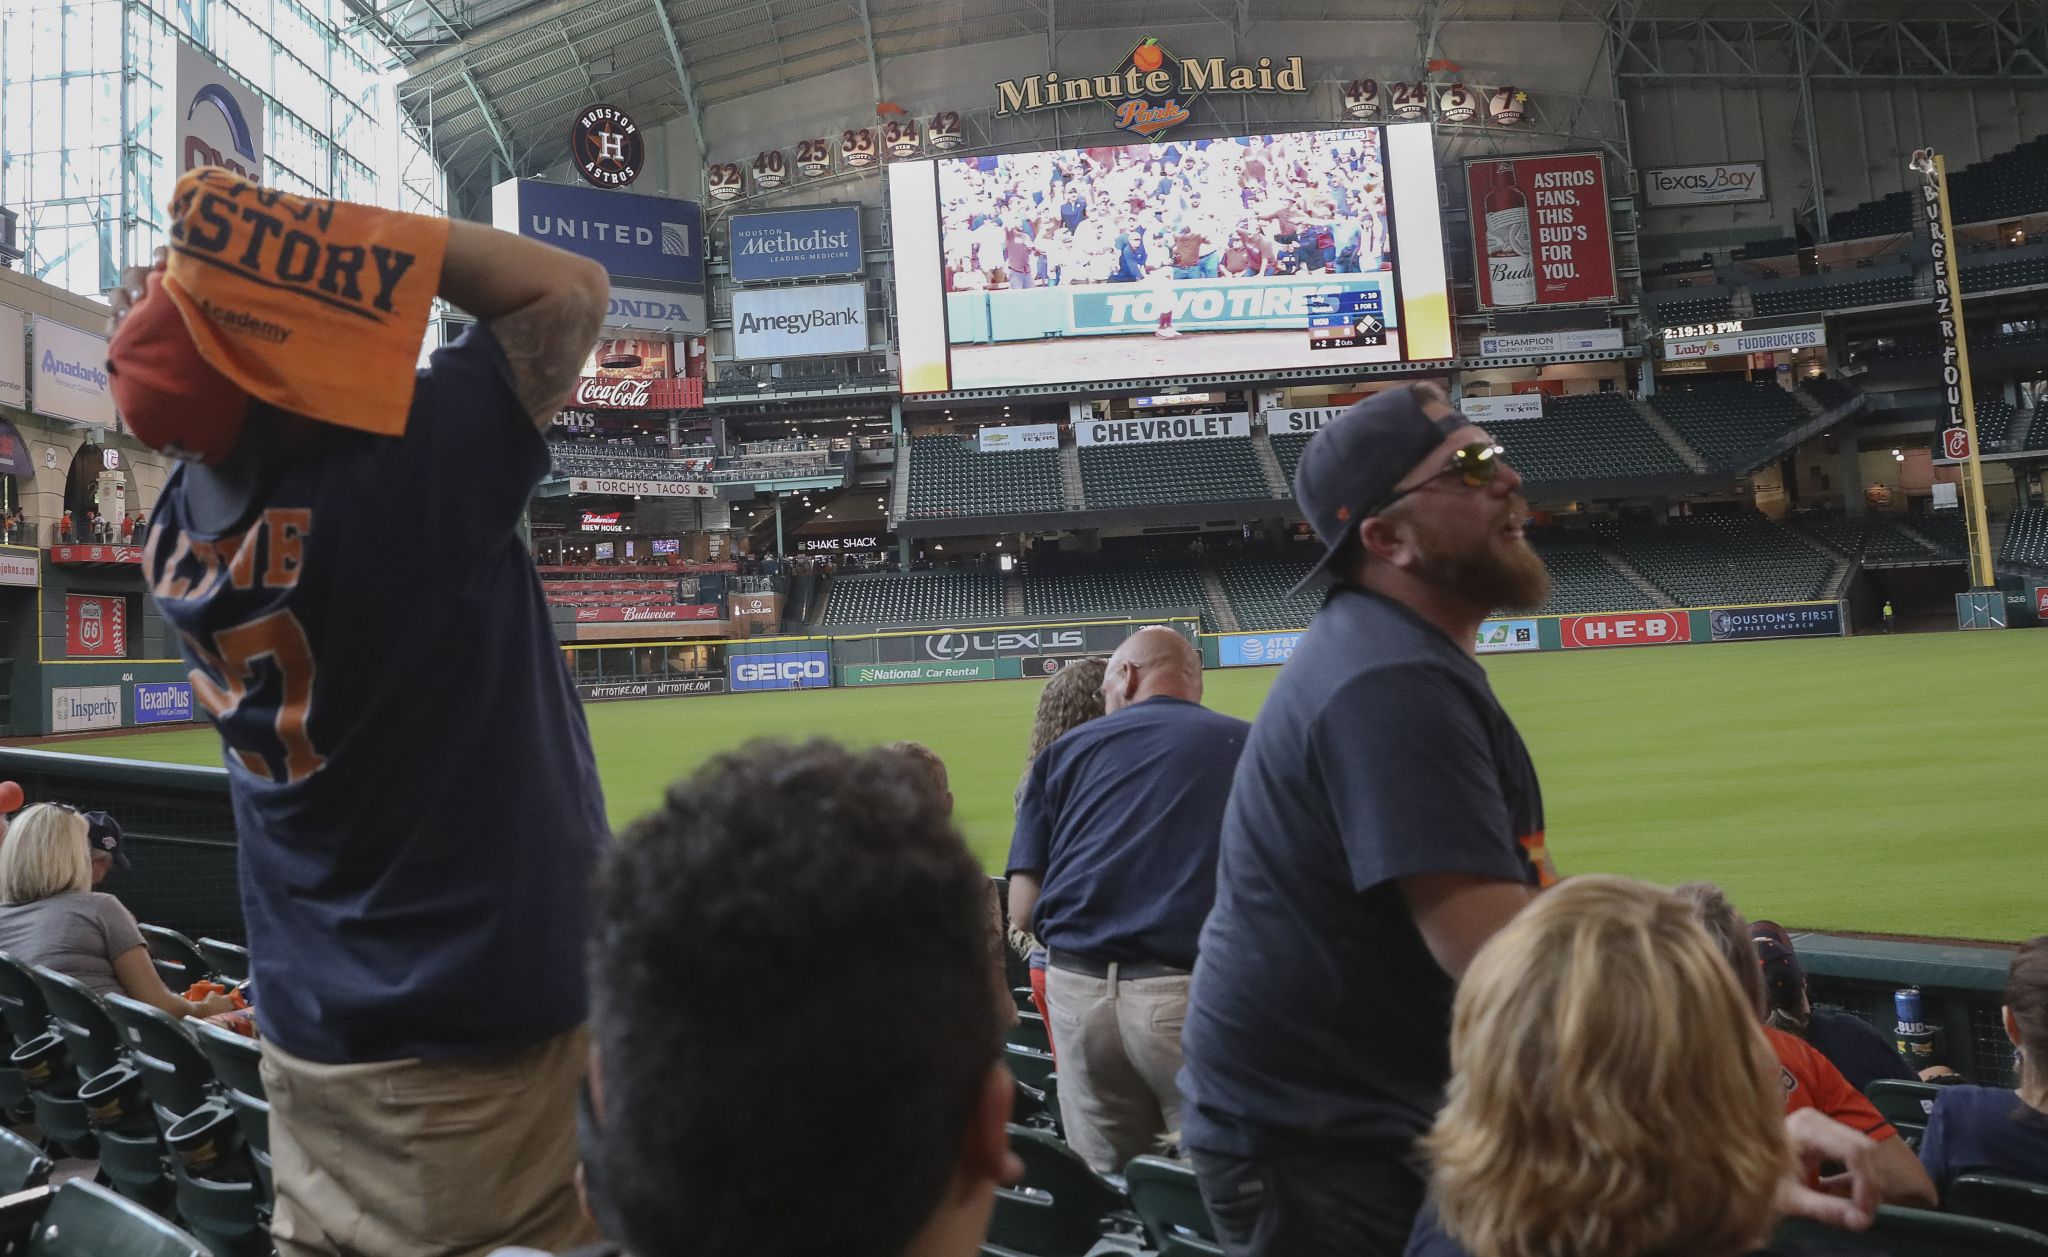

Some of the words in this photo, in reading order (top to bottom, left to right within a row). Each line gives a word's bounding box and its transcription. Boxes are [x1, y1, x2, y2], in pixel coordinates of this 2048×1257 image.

[997, 66, 1170, 115] Minute
[1179, 55, 1308, 92] Maid
[1346, 79, 1378, 102] 49
[1393, 81, 1427, 104] 24
[1452, 83, 1467, 106] 5
[1498, 86, 1515, 109] 7
[581, 108, 636, 134] HOUSTON
[928, 111, 959, 134] 42
[1115, 98, 1183, 130] Park
[843, 129, 872, 152] 33
[887, 119, 917, 143] 34
[598, 131, 625, 161] H
[797, 139, 827, 163] 25
[585, 162, 634, 184] ASTROS
[753, 150, 782, 174] 40
[709, 163, 739, 186] 32
[1534, 169, 1595, 189] ASTROS
[1650, 171, 1708, 191] Texas
[1708, 167, 1756, 192] Bay
[1536, 190, 1581, 207] FANS,
[1538, 208, 1574, 225] THIS
[532, 214, 653, 246] UNITED
[738, 229, 782, 237] HOUSTON
[1539, 225, 1588, 243] BUD'S
[171, 190, 415, 313] STORY
[740, 229, 849, 255] Methodist
[1541, 244, 1573, 262] FOR
[770, 254, 806, 263] LEADING
[809, 251, 849, 260] MEDICINE
[1542, 263, 1580, 280] YOU.
[606, 299, 690, 322] ONDA
[738, 307, 859, 335] AmegyBank
[1664, 325, 1714, 339] 2:19:13
[1716, 321, 1743, 334] PM
[1498, 338, 1554, 347] CHAMPION
[1674, 342, 1720, 356] Luby's
[1737, 332, 1816, 350] FUDDRUCKERS
[42, 349, 108, 390] Anadarko
[577, 378, 652, 407] Coca-Cola
[552, 411, 595, 426] CHYS
[1092, 416, 1232, 442] CHEVROLET
[596, 481, 649, 493] TORCHYS
[656, 483, 691, 494] TACOS
[807, 540, 839, 550] SHAKE
[843, 537, 877, 548] SHACK
[621, 607, 676, 620] Budweiser
[1723, 613, 1795, 625] HOUSTON'S
[1801, 610, 1834, 620] FIRST
[83, 621, 98, 639] 66
[974, 631, 1083, 650] LEXUS
[1585, 618, 1667, 640] H-E-B
[1266, 637, 1298, 648] AT&T
[122, 673, 133, 682] 404
[737, 661, 825, 682] GEICO
[873, 669, 921, 680] National
[926, 669, 945, 677] Car
[946, 668, 979, 676] Rental
[139, 687, 189, 710] TexanPlus
[591, 684, 648, 697] NITTOTIRE.COM
[657, 680, 711, 693] NITTOTIRE.COM
[71, 697, 117, 721] Insperity
[1898, 1021, 1924, 1033] BUD
